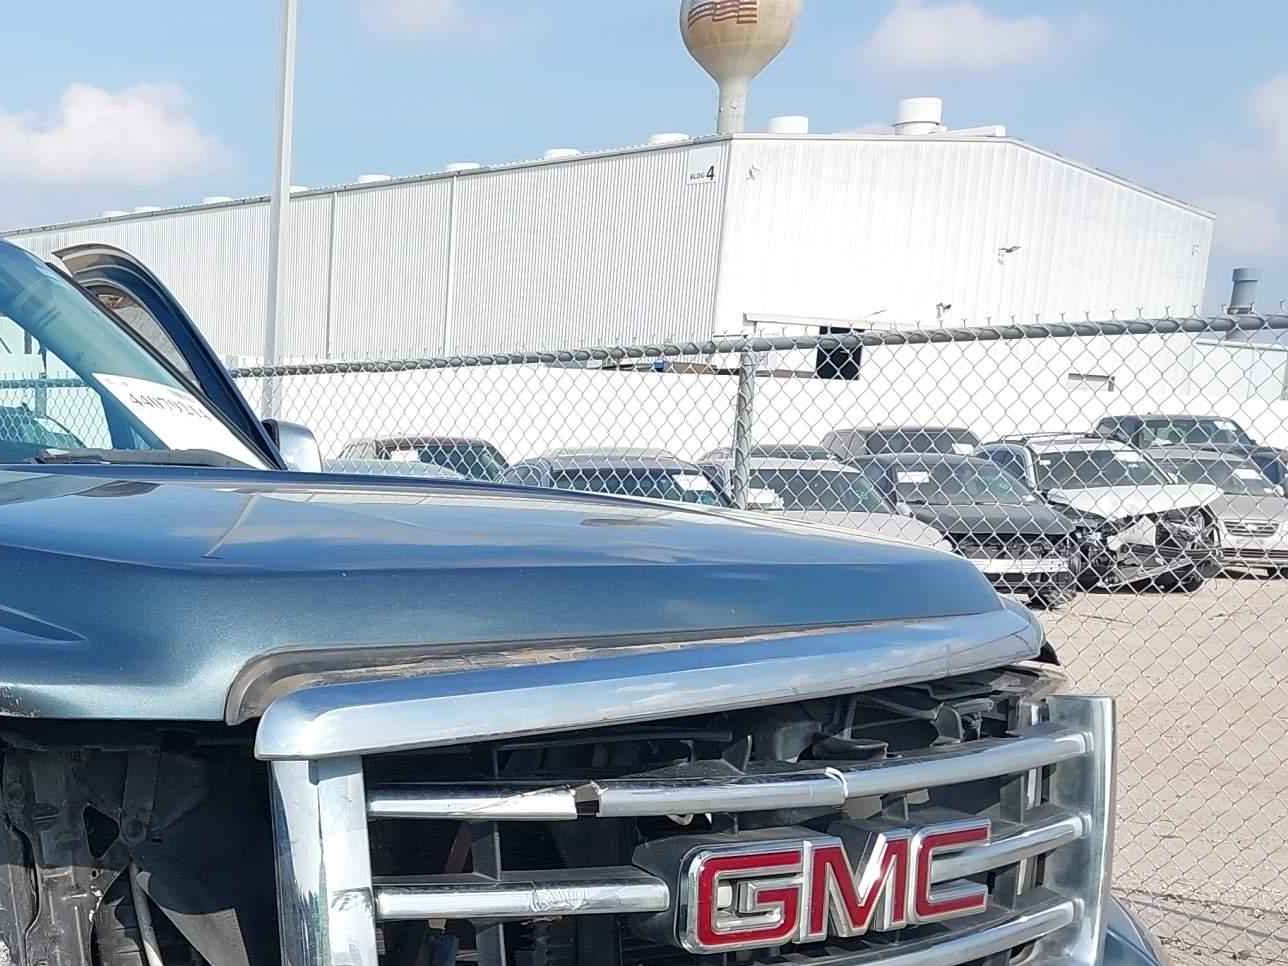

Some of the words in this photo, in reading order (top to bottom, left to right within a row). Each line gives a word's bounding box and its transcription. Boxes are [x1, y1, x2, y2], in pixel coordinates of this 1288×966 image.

[690, 172, 705, 180] BLDG
[706, 165, 715, 181] 4
[678, 817, 992, 954] GMC
